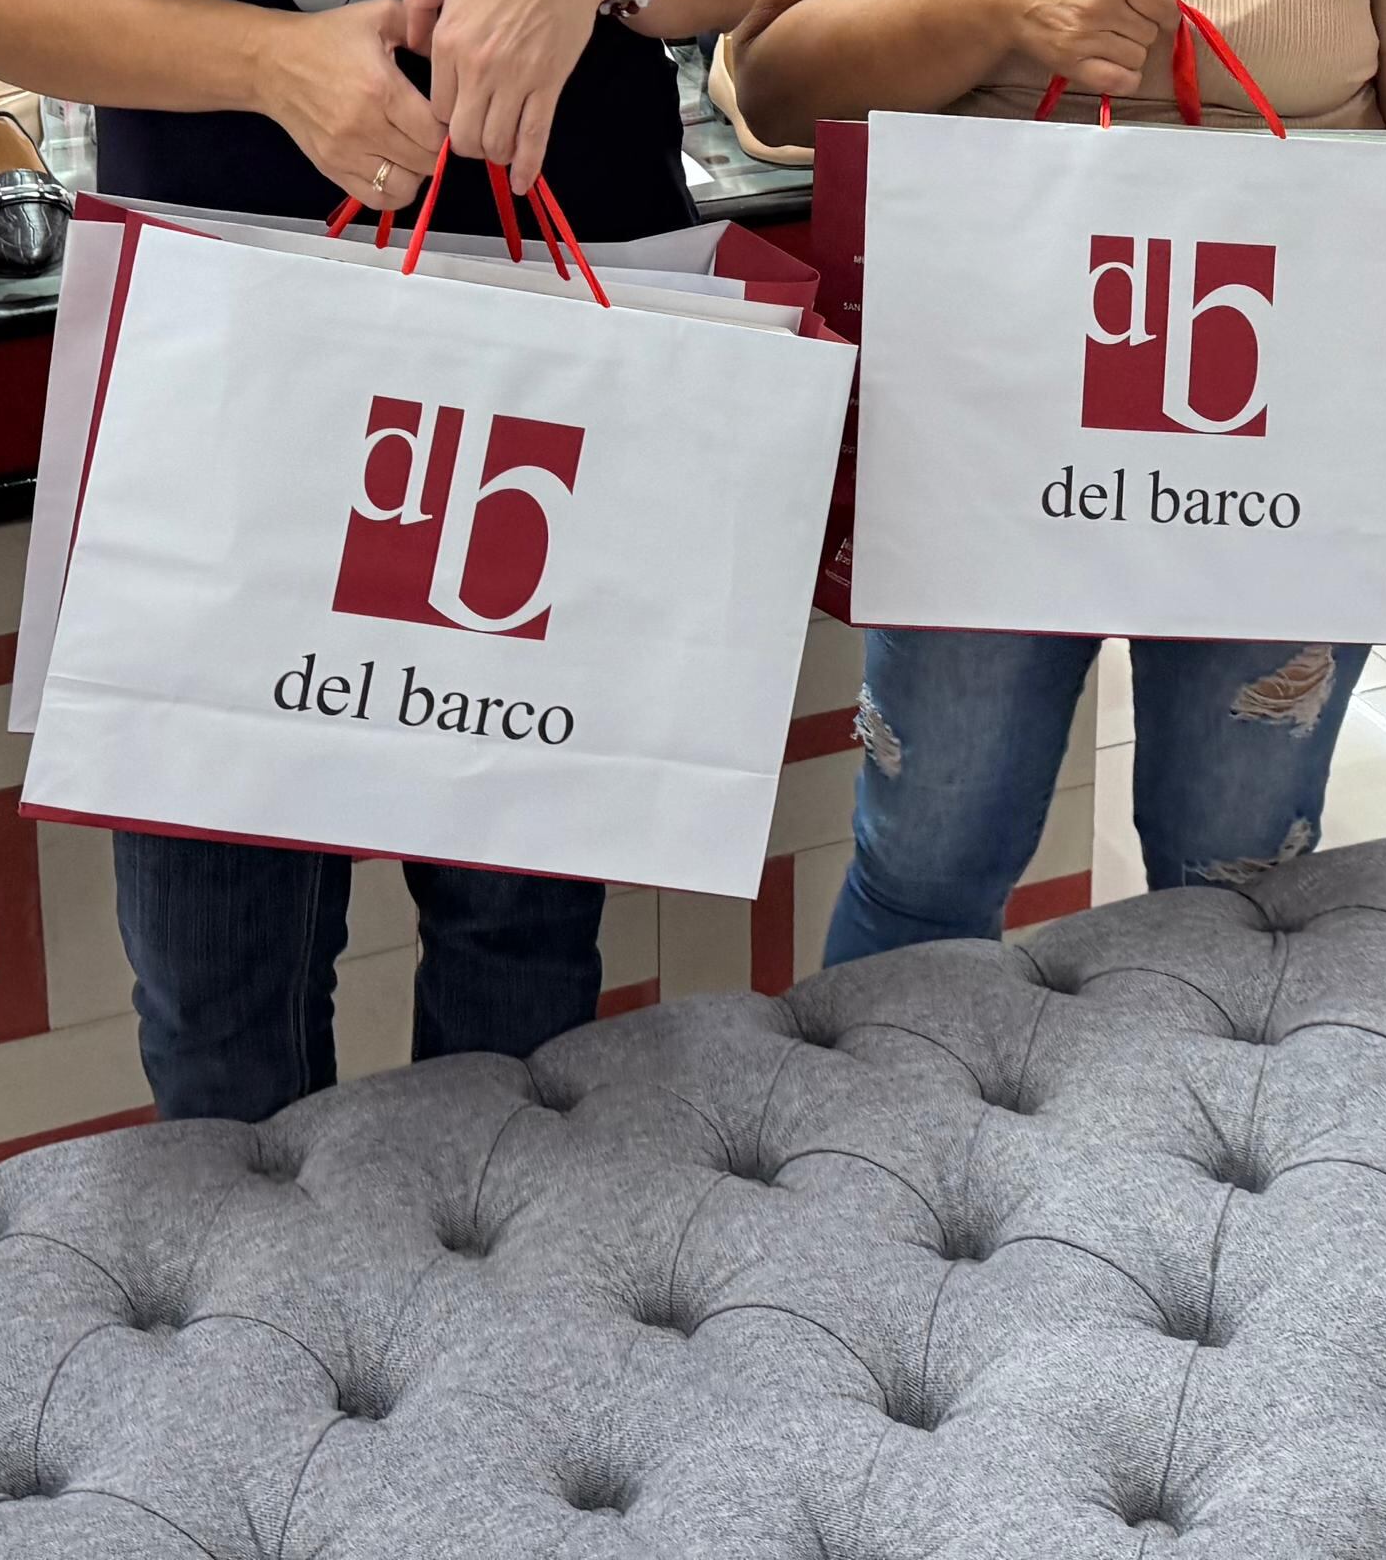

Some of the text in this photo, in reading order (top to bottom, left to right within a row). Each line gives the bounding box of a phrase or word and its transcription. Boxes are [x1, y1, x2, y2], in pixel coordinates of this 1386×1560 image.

[1081, 234, 1277, 437] db
[332, 395, 586, 641] db
[1041, 465, 1301, 529] del barco
[274, 653, 575, 745] del barco
